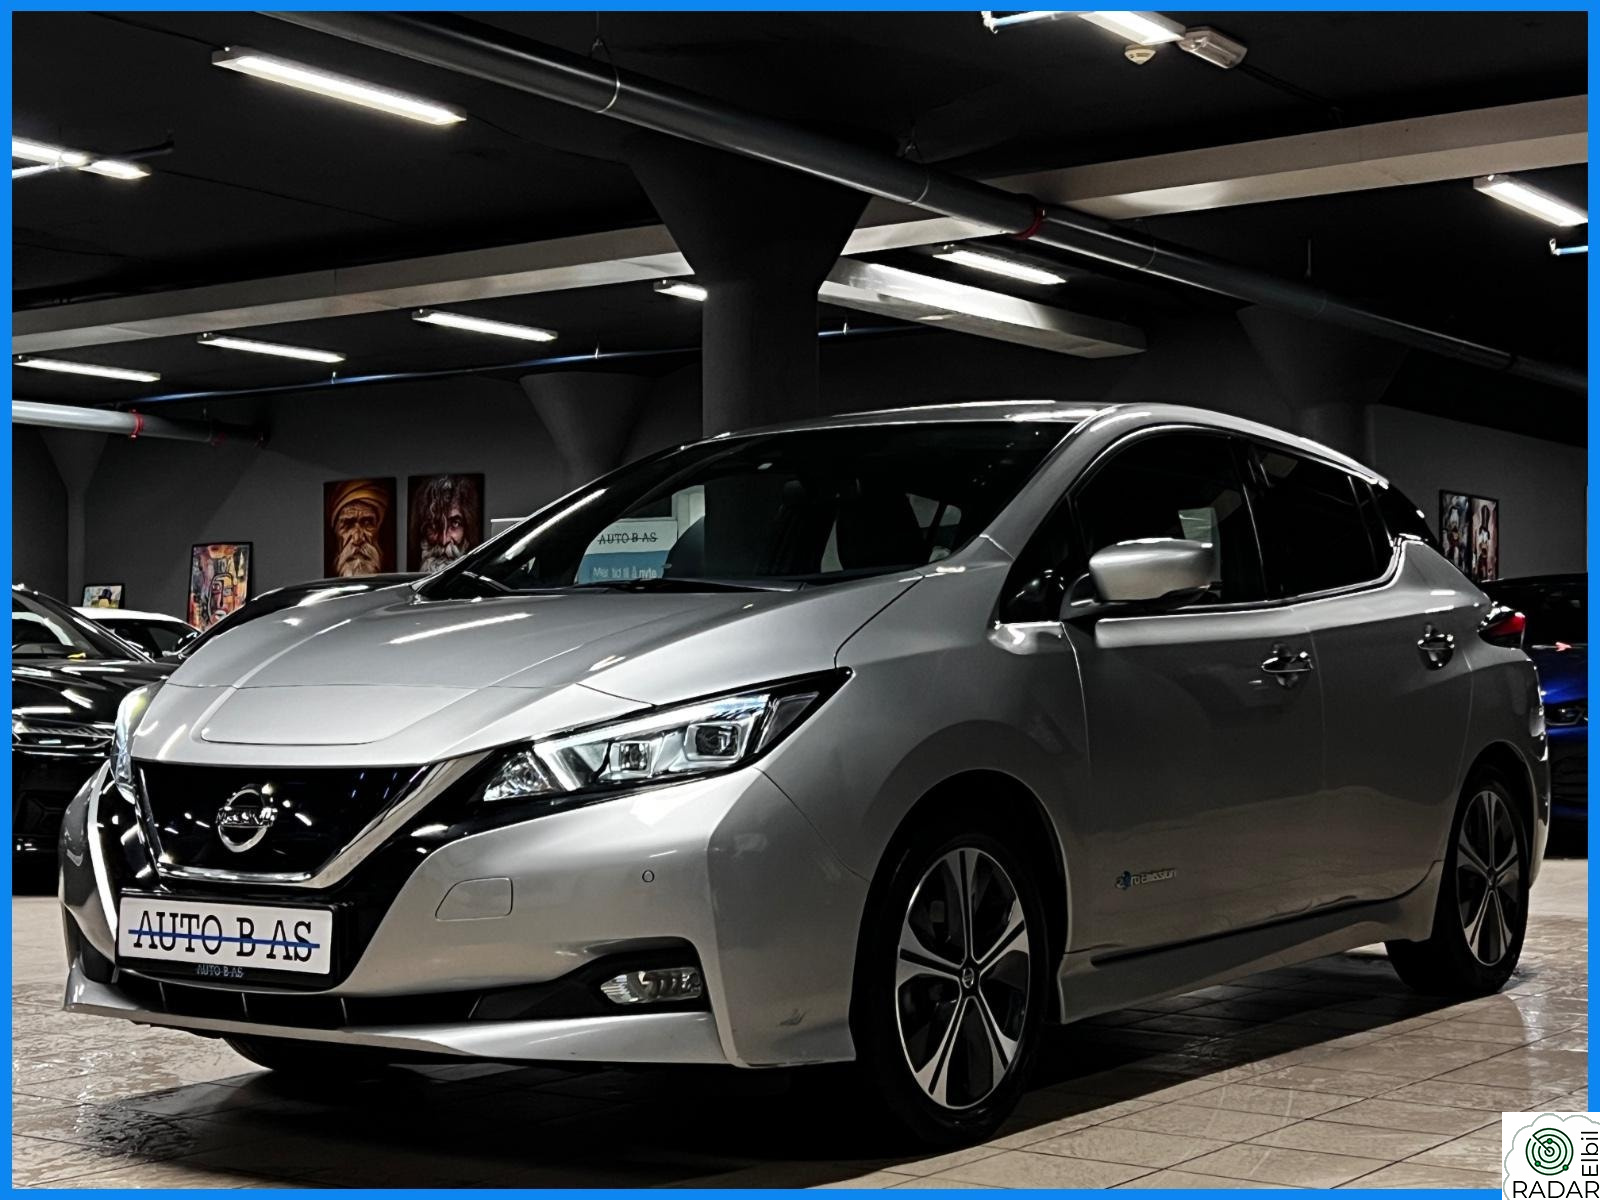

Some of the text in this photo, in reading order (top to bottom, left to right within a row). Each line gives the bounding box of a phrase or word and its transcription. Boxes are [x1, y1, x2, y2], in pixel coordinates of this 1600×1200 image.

[598, 532, 657, 545] AUTO B AS
[133, 910, 312, 962] AUTO B AS
[196, 964, 244, 978] AUTO B AS
